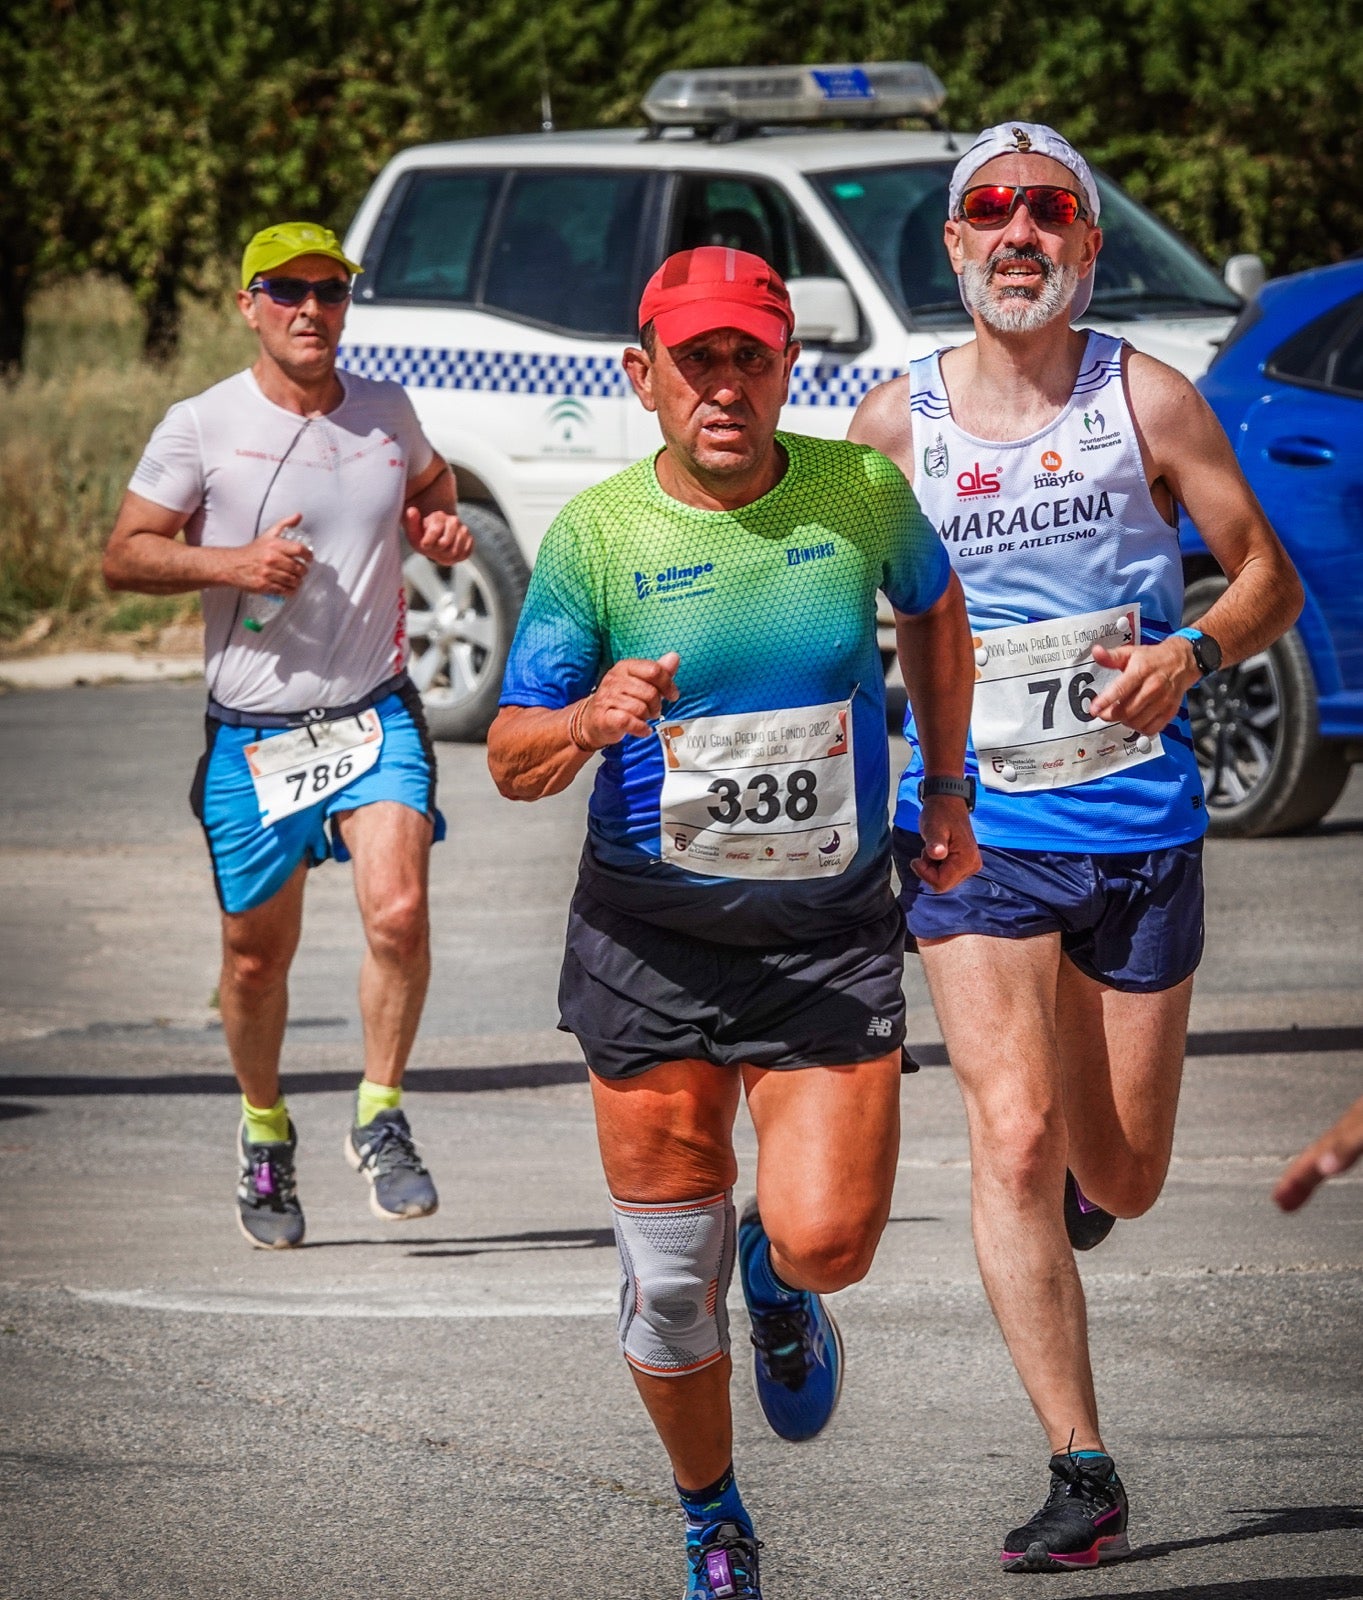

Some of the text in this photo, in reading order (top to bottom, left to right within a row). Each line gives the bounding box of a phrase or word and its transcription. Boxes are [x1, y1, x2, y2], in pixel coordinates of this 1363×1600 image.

[1079, 431, 1121, 445] Ayuntamiento
[1086, 439, 1122, 451] Maracena
[1033, 470, 1085, 489] mayfo
[938, 491, 1114, 542] MARACENA
[959, 527, 1097, 557] CLUB DE ATLETISMO
[656, 563, 713, 582] olimpo
[1007, 640, 1029, 656] GRAN
[1030, 636, 1060, 651] PREMIO
[1061, 634, 1072, 647] DE
[1074, 629, 1098, 644] FONDO
[1028, 651, 1060, 666] UNIVERSO
[1027, 671, 1098, 730] 76
[710, 733, 733, 748] GRAN
[767, 730, 778, 742] DE
[780, 726, 807, 741] FONDO
[808, 720, 830, 738] 2022
[285, 754, 353, 802] 786
[706, 769, 818, 824] 338
[818, 853, 842, 868] Lorca
